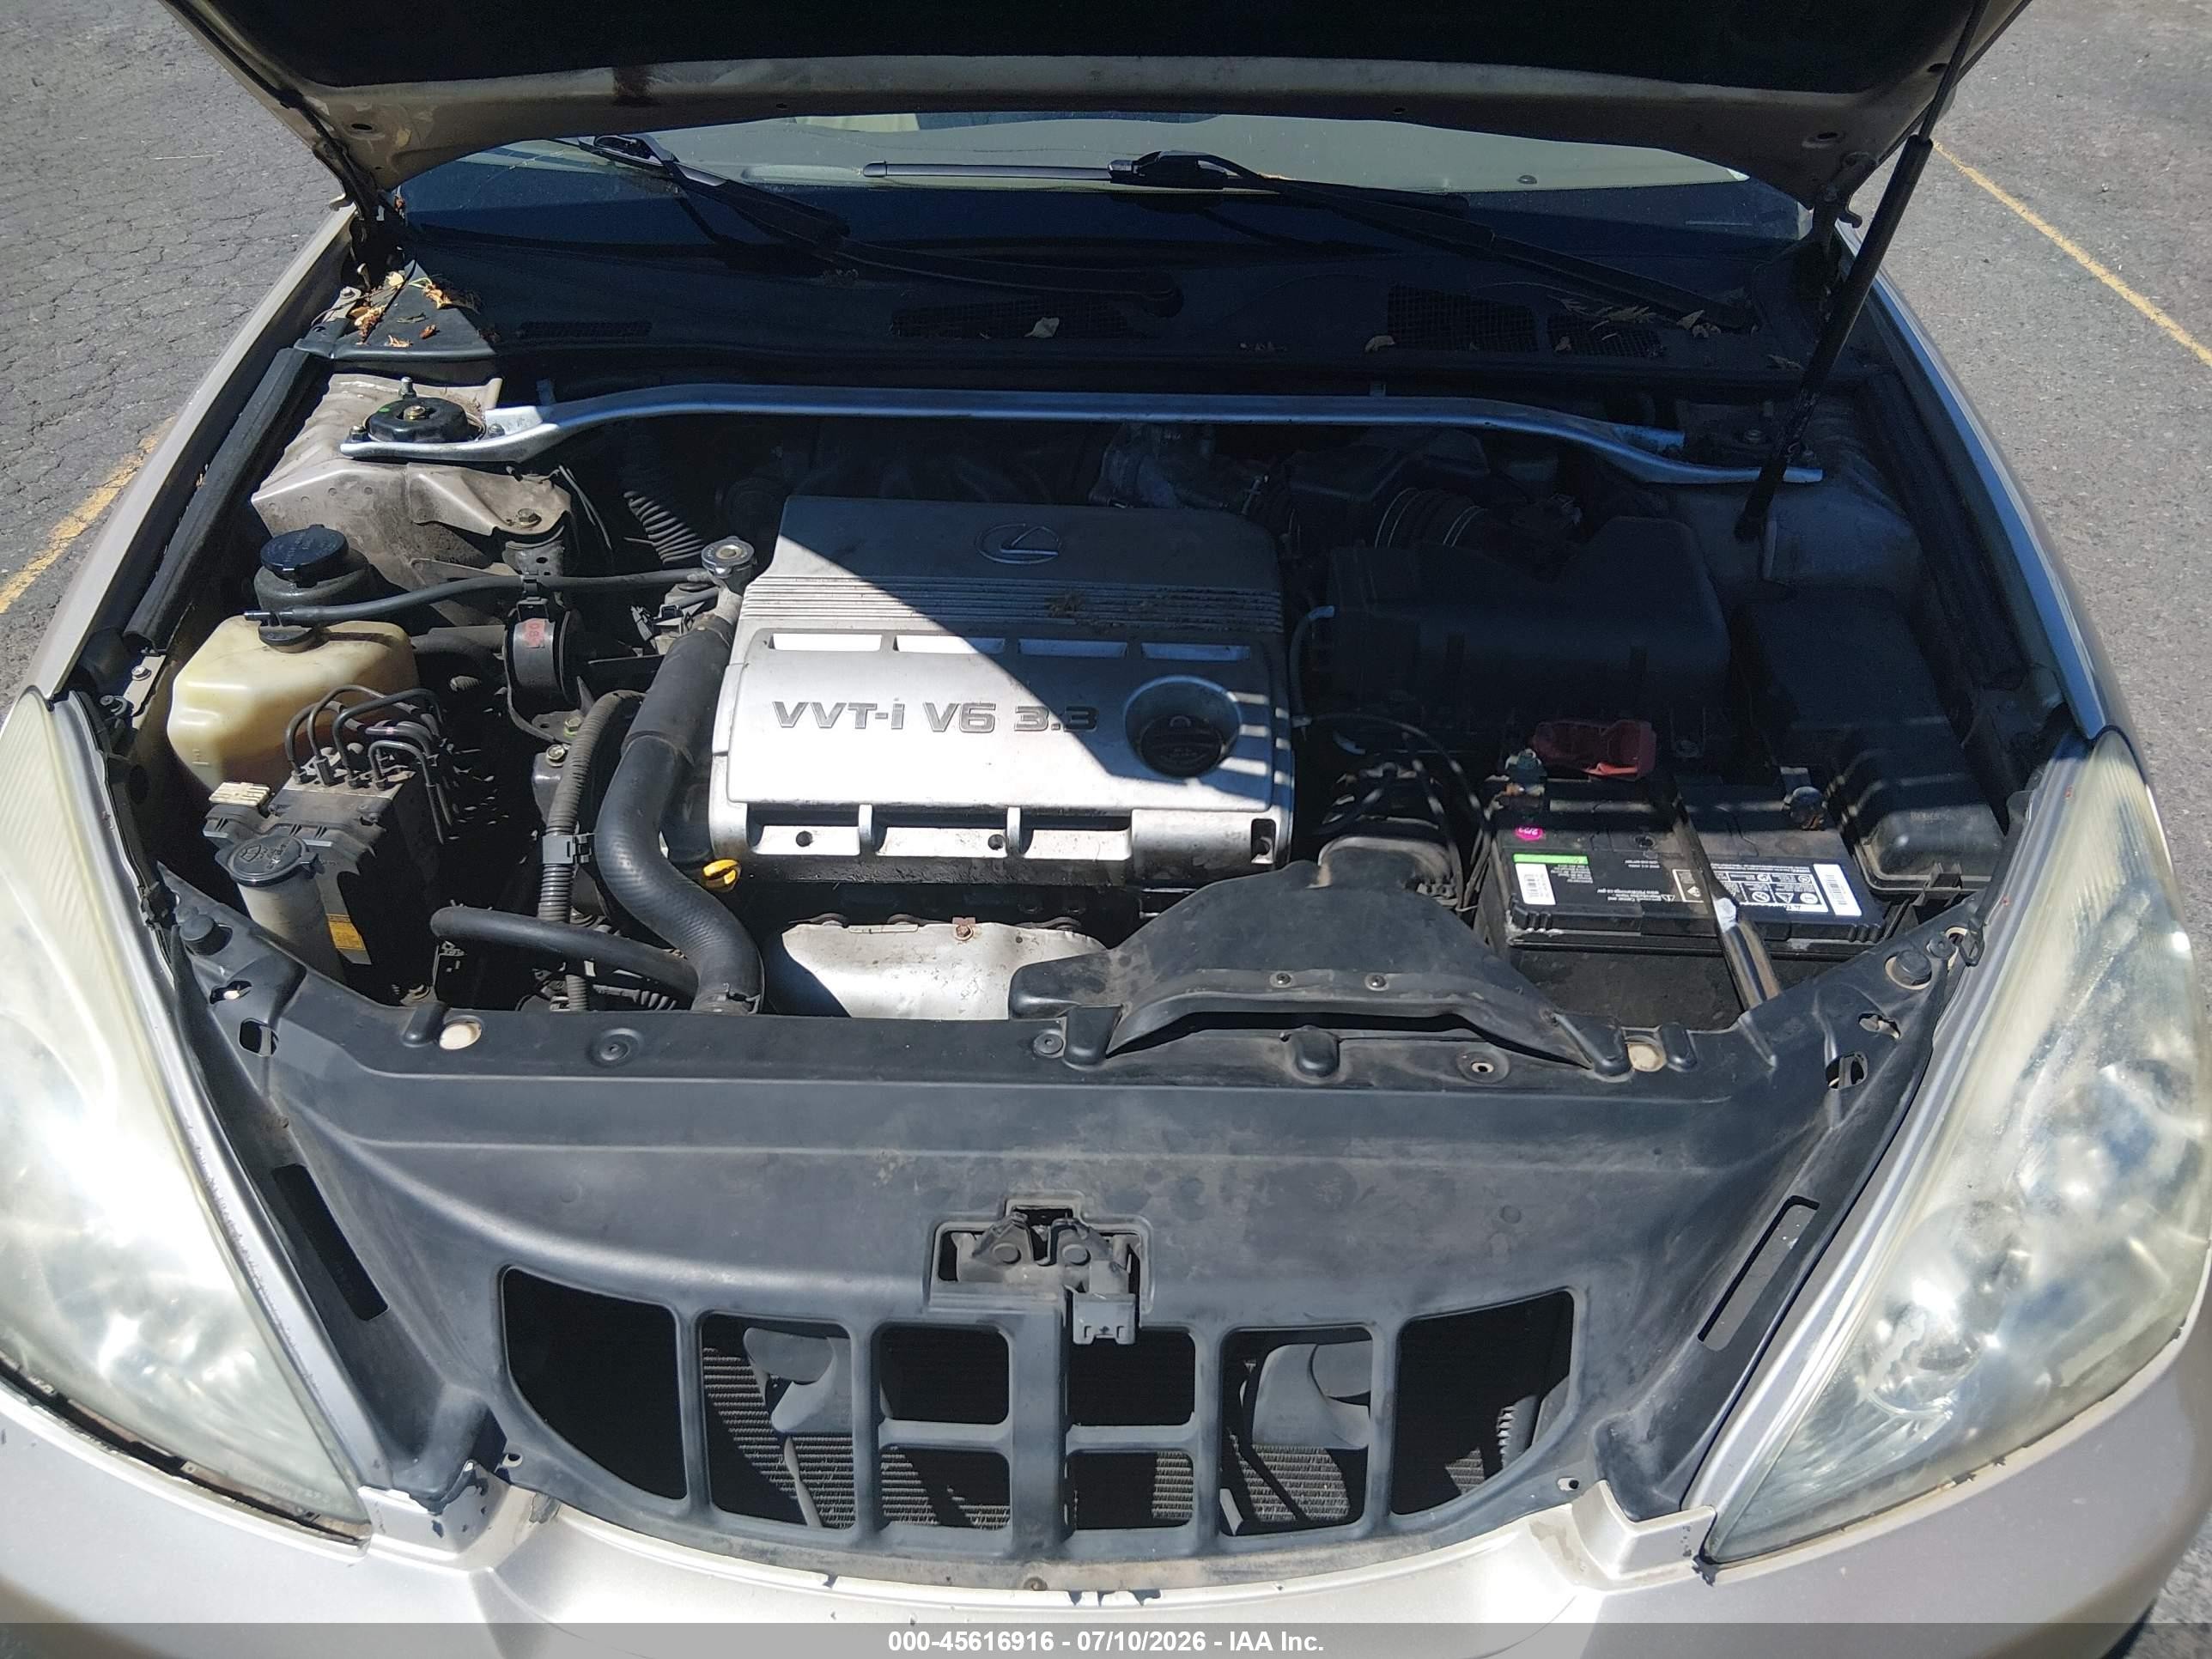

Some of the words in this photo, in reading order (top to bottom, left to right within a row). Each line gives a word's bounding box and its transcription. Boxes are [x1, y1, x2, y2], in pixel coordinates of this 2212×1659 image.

[773, 697, 905, 730] VVT-i
[923, 702, 997, 732] V6
[1014, 705, 1099, 732] 3.3
